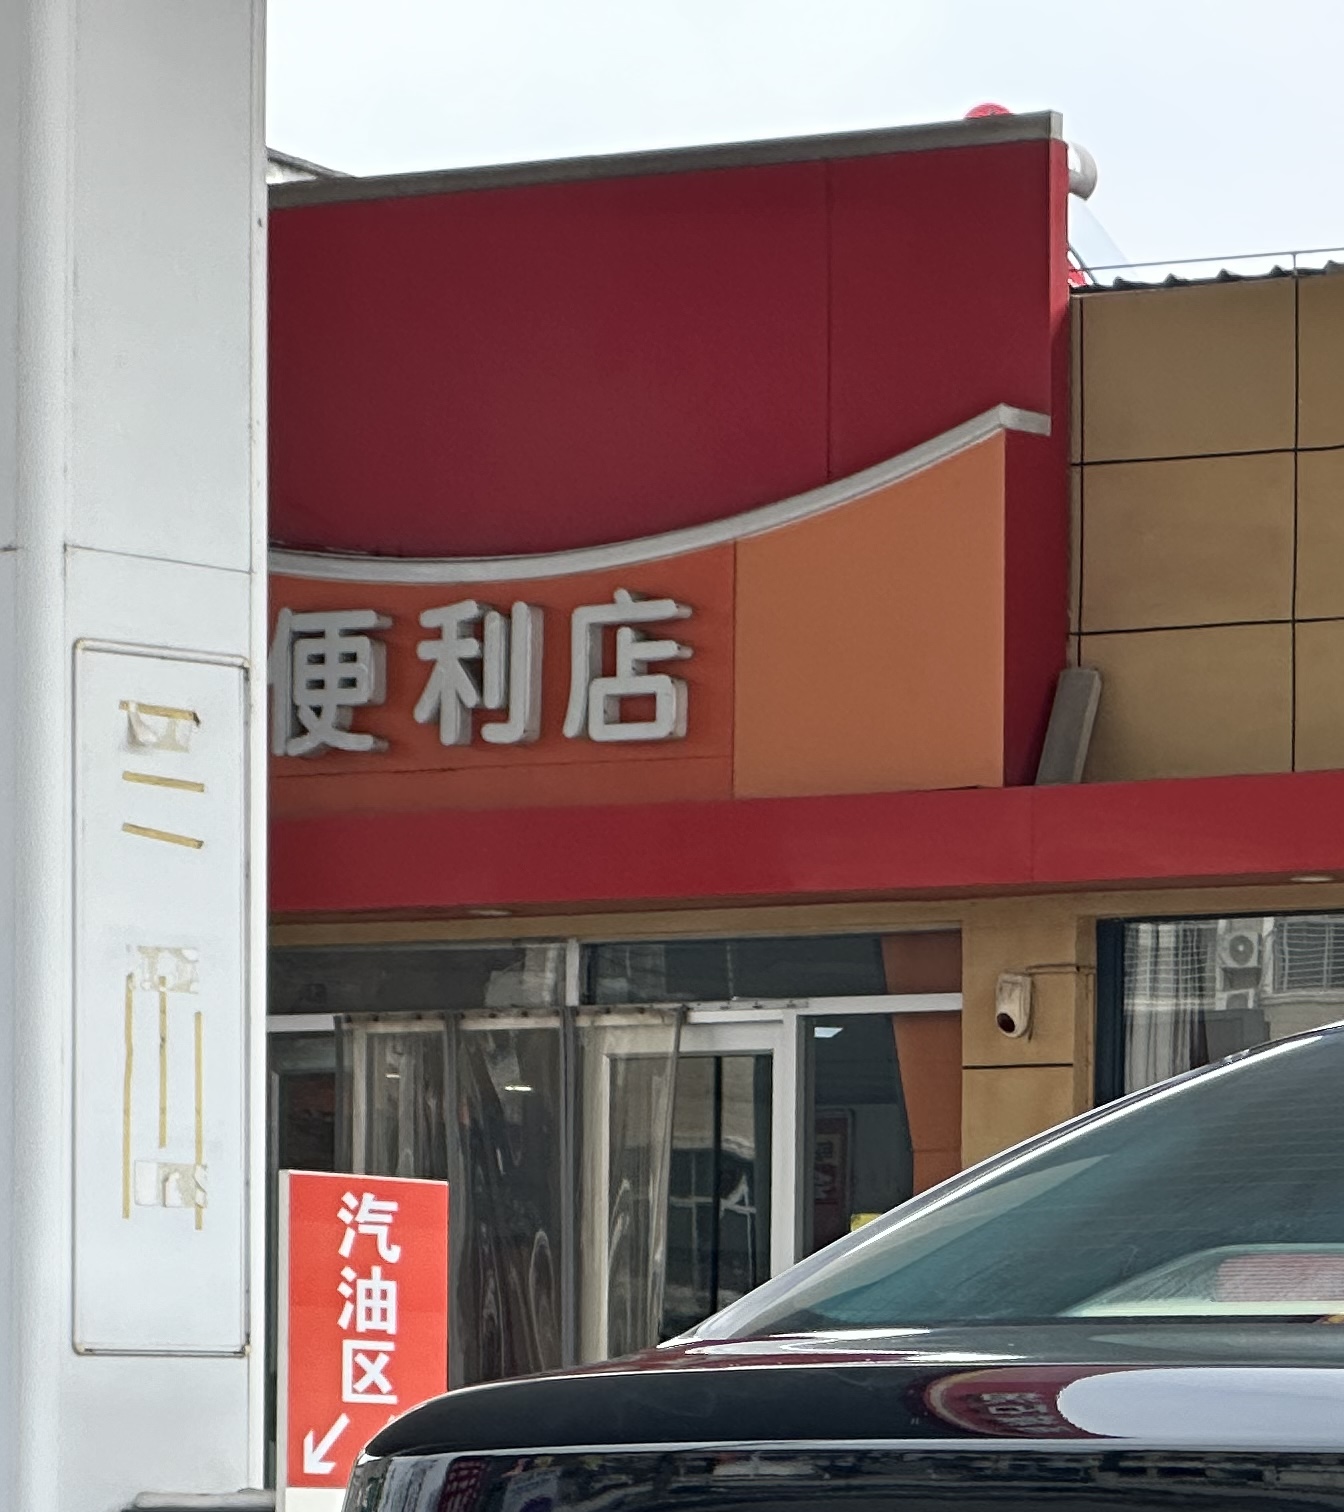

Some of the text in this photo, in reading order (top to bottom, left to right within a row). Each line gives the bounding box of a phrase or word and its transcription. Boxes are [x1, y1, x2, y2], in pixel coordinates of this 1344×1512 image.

[267, 588, 693, 757] 便利店
[336, 1191, 401, 1405] 汽油区
